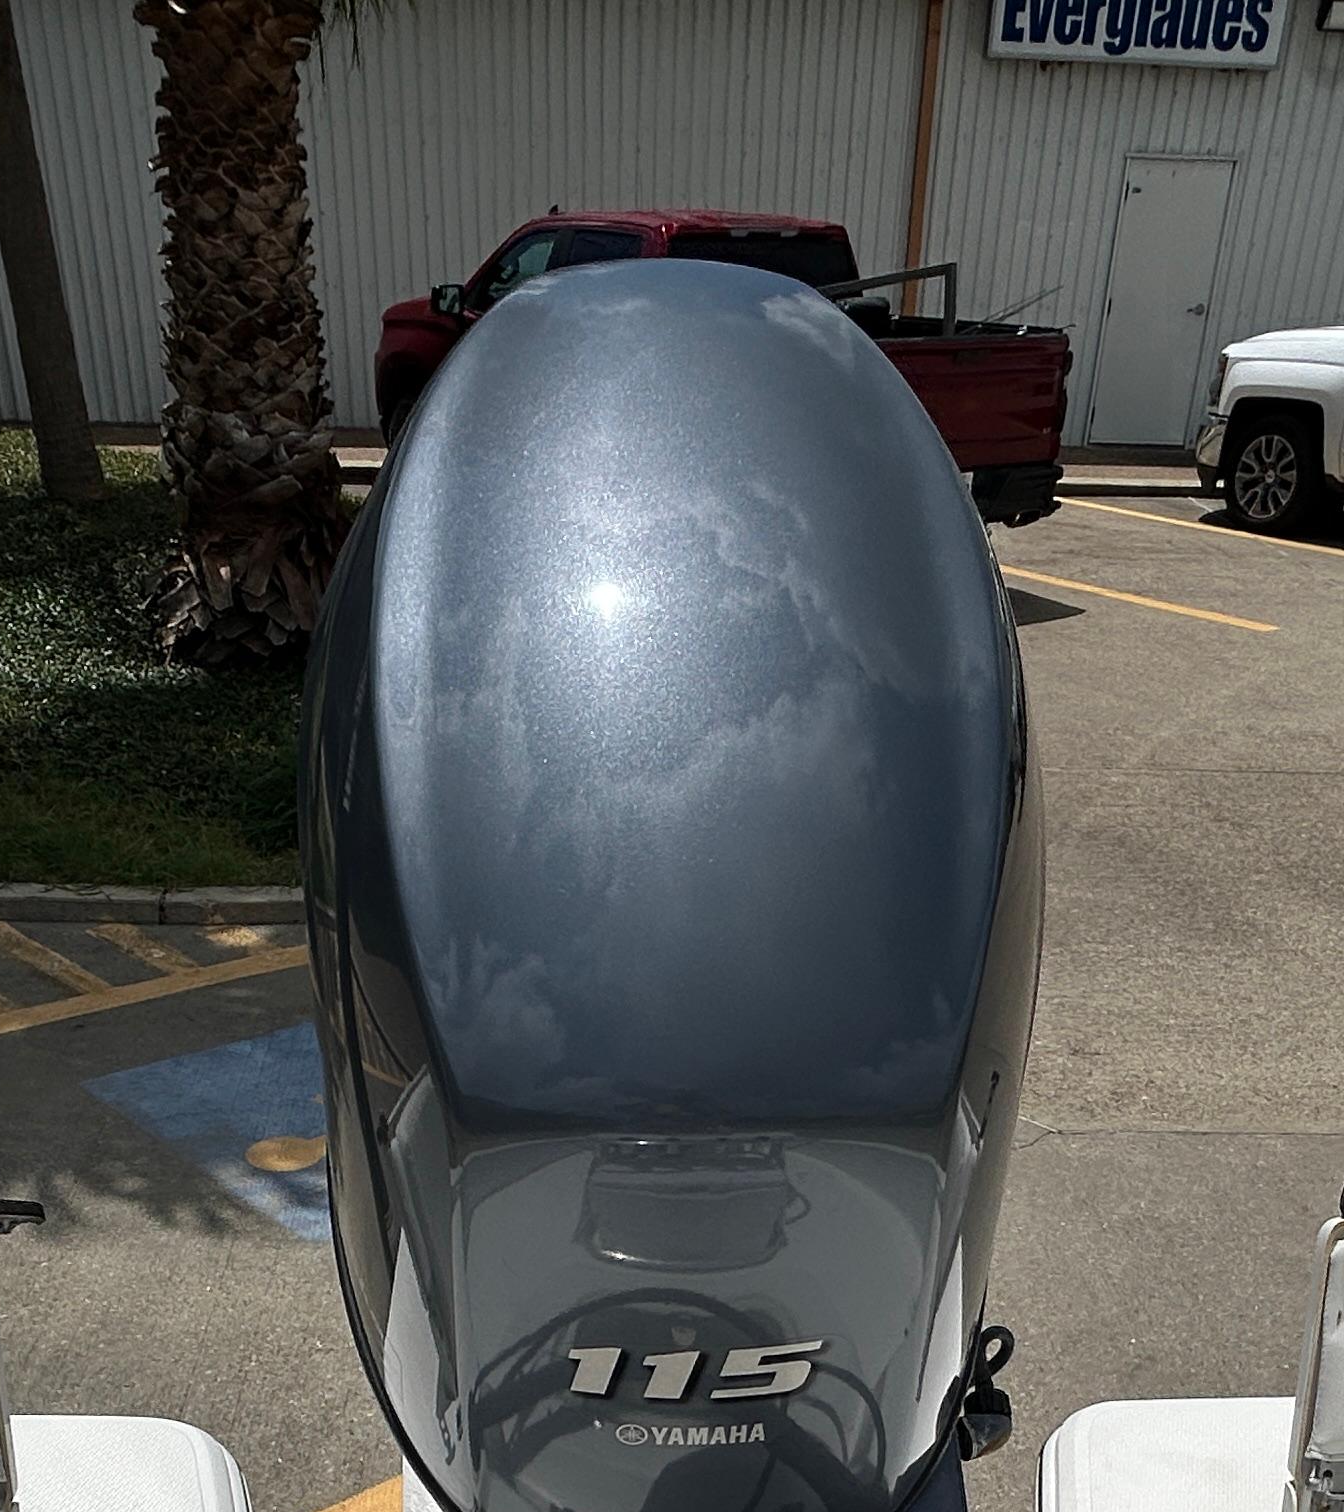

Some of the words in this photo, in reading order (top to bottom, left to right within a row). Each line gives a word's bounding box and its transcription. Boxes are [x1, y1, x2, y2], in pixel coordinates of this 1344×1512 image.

[1001, 0, 1273, 55] Everglades
[568, 1339, 824, 1400] 115
[651, 1422, 766, 1446] YAMAHA
